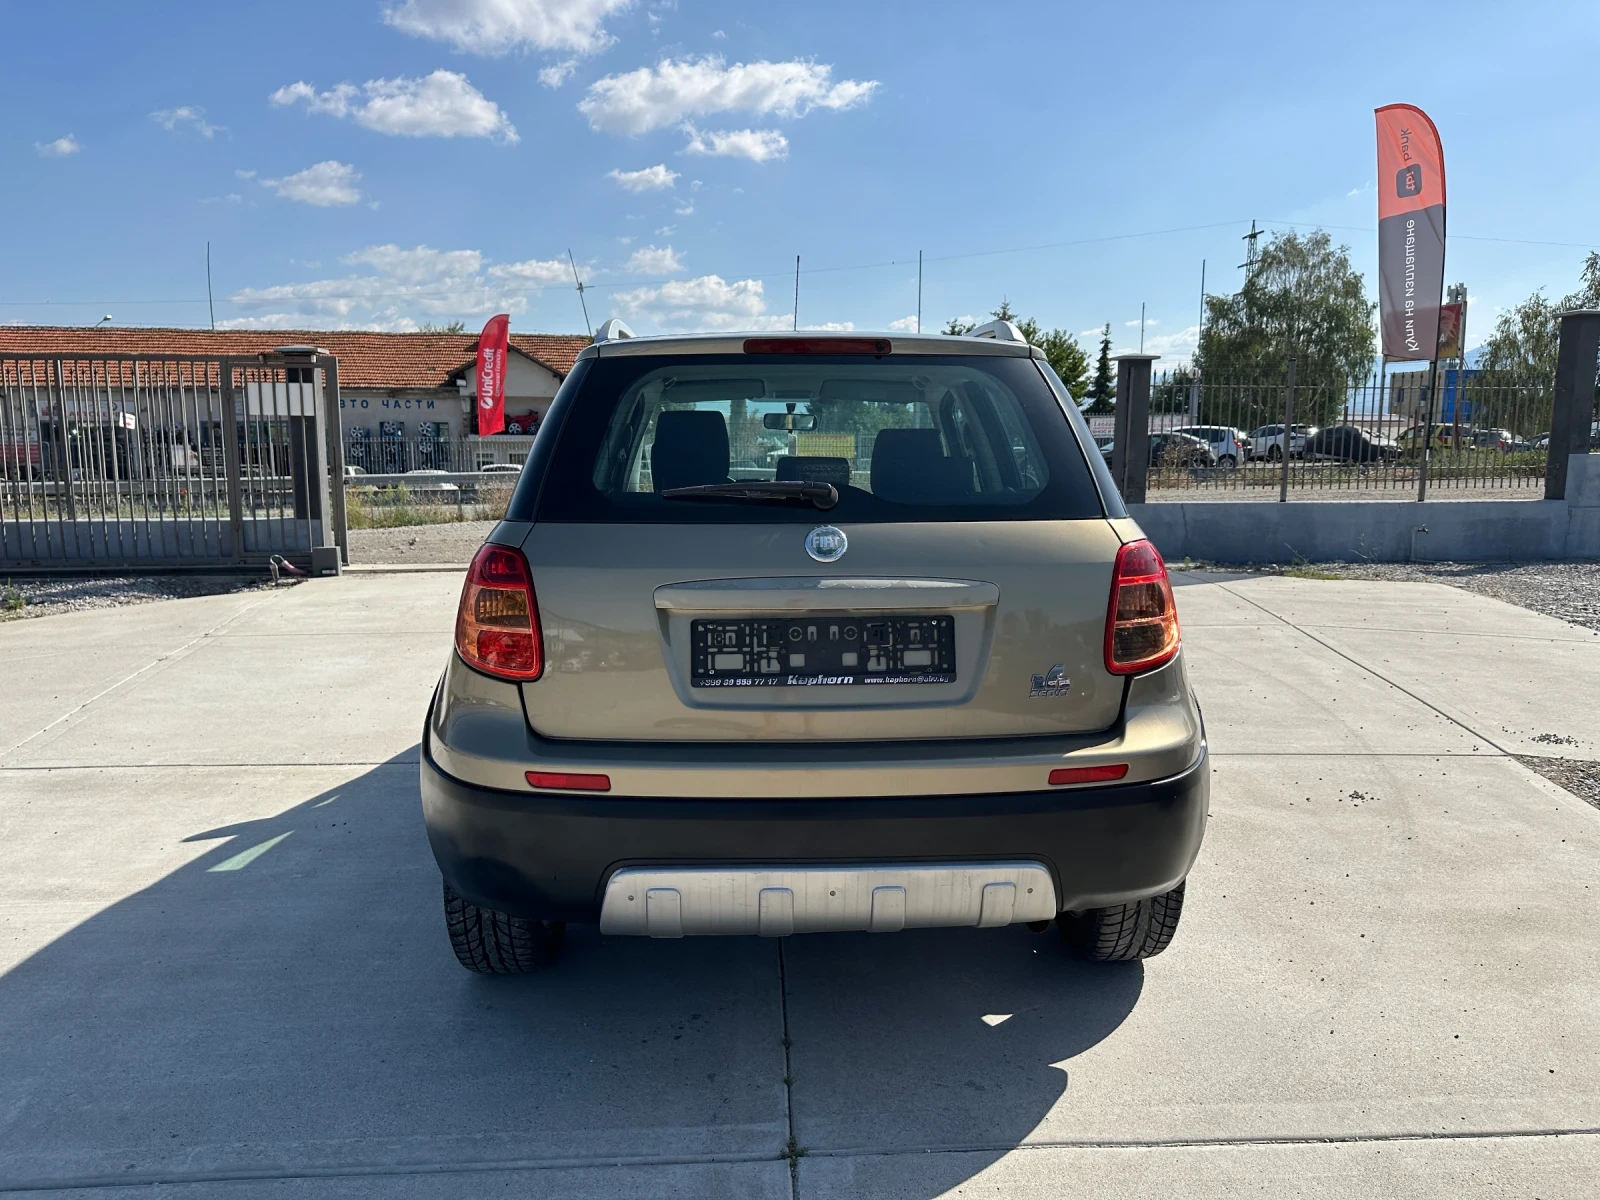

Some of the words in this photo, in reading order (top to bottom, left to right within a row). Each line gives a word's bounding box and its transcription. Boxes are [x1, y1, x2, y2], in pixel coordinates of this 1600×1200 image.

[481, 348, 494, 396] UniCredit
[339, 400, 369, 409] ВТО
[381, 400, 435, 409] ЧАСТИ
[812, 536, 840, 548] FIAT
[787, 674, 854, 686] Kaphorn
